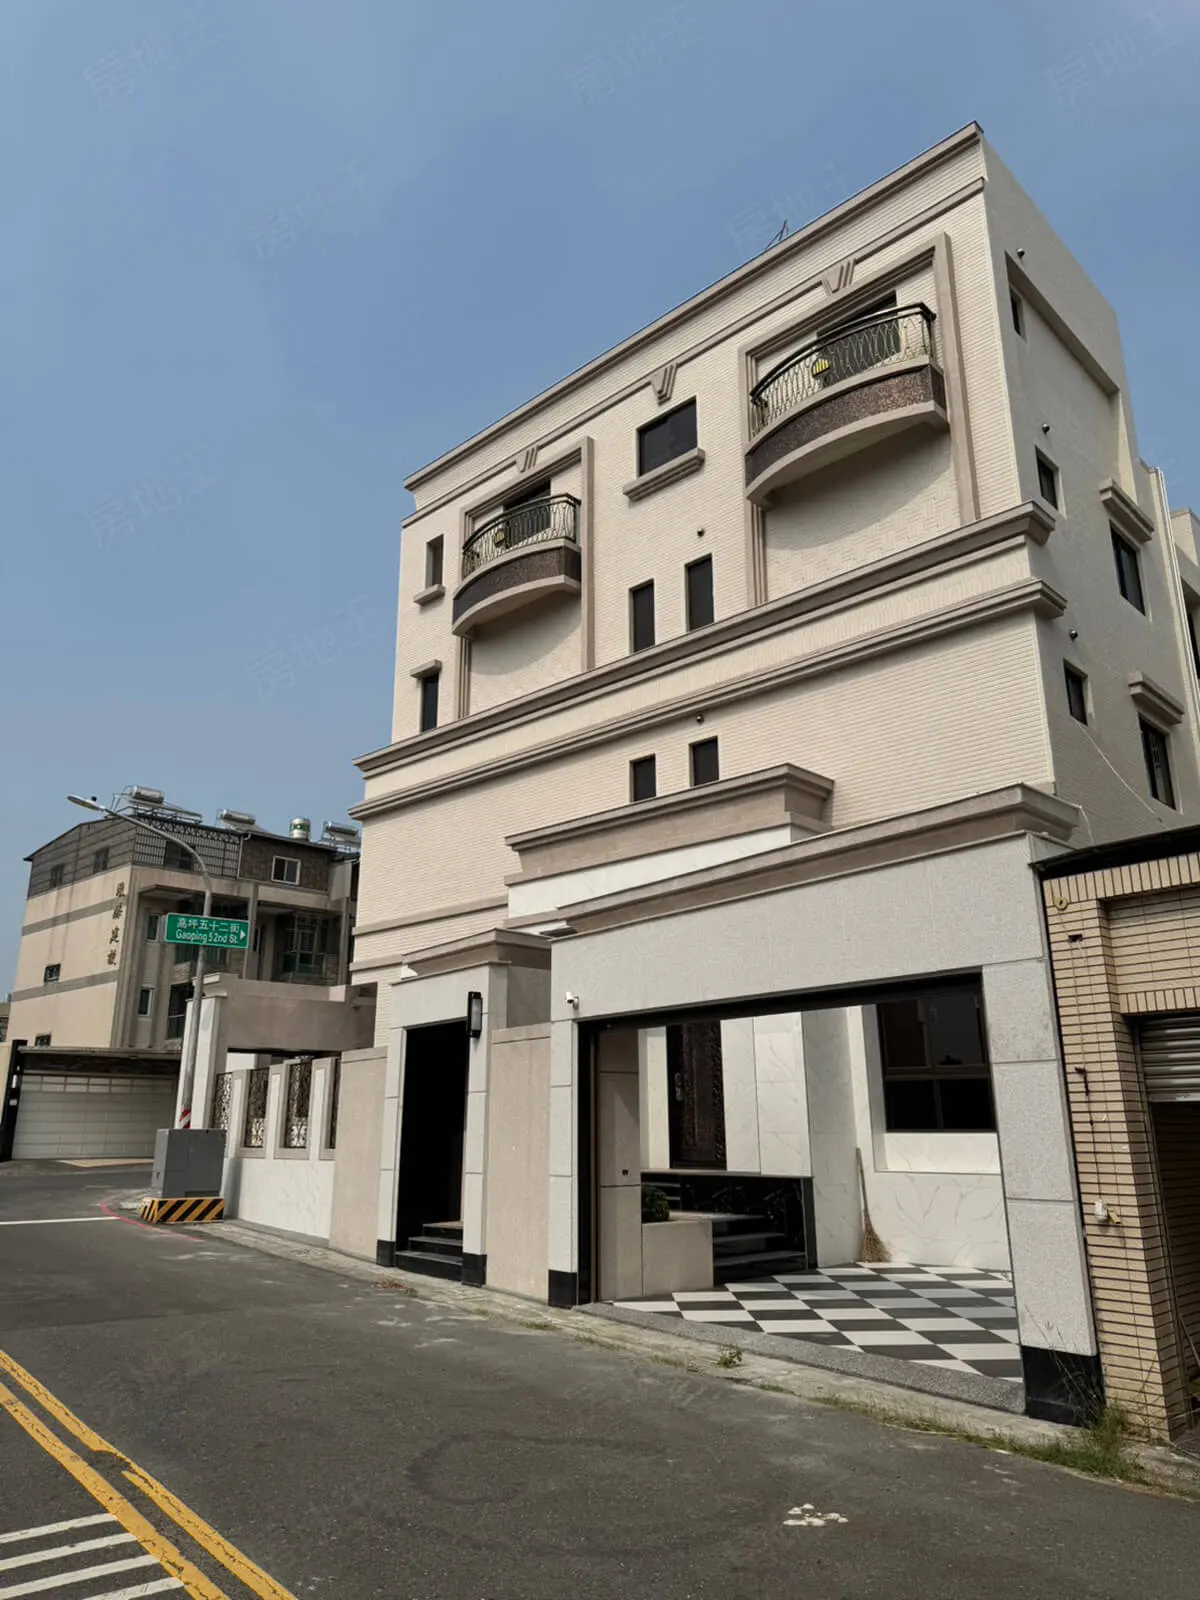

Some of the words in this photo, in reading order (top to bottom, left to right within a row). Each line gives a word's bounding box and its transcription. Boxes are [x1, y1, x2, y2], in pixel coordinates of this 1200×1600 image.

[177, 917, 240, 933] 高坪五十二街
[175, 929, 207, 945] Gaoping
